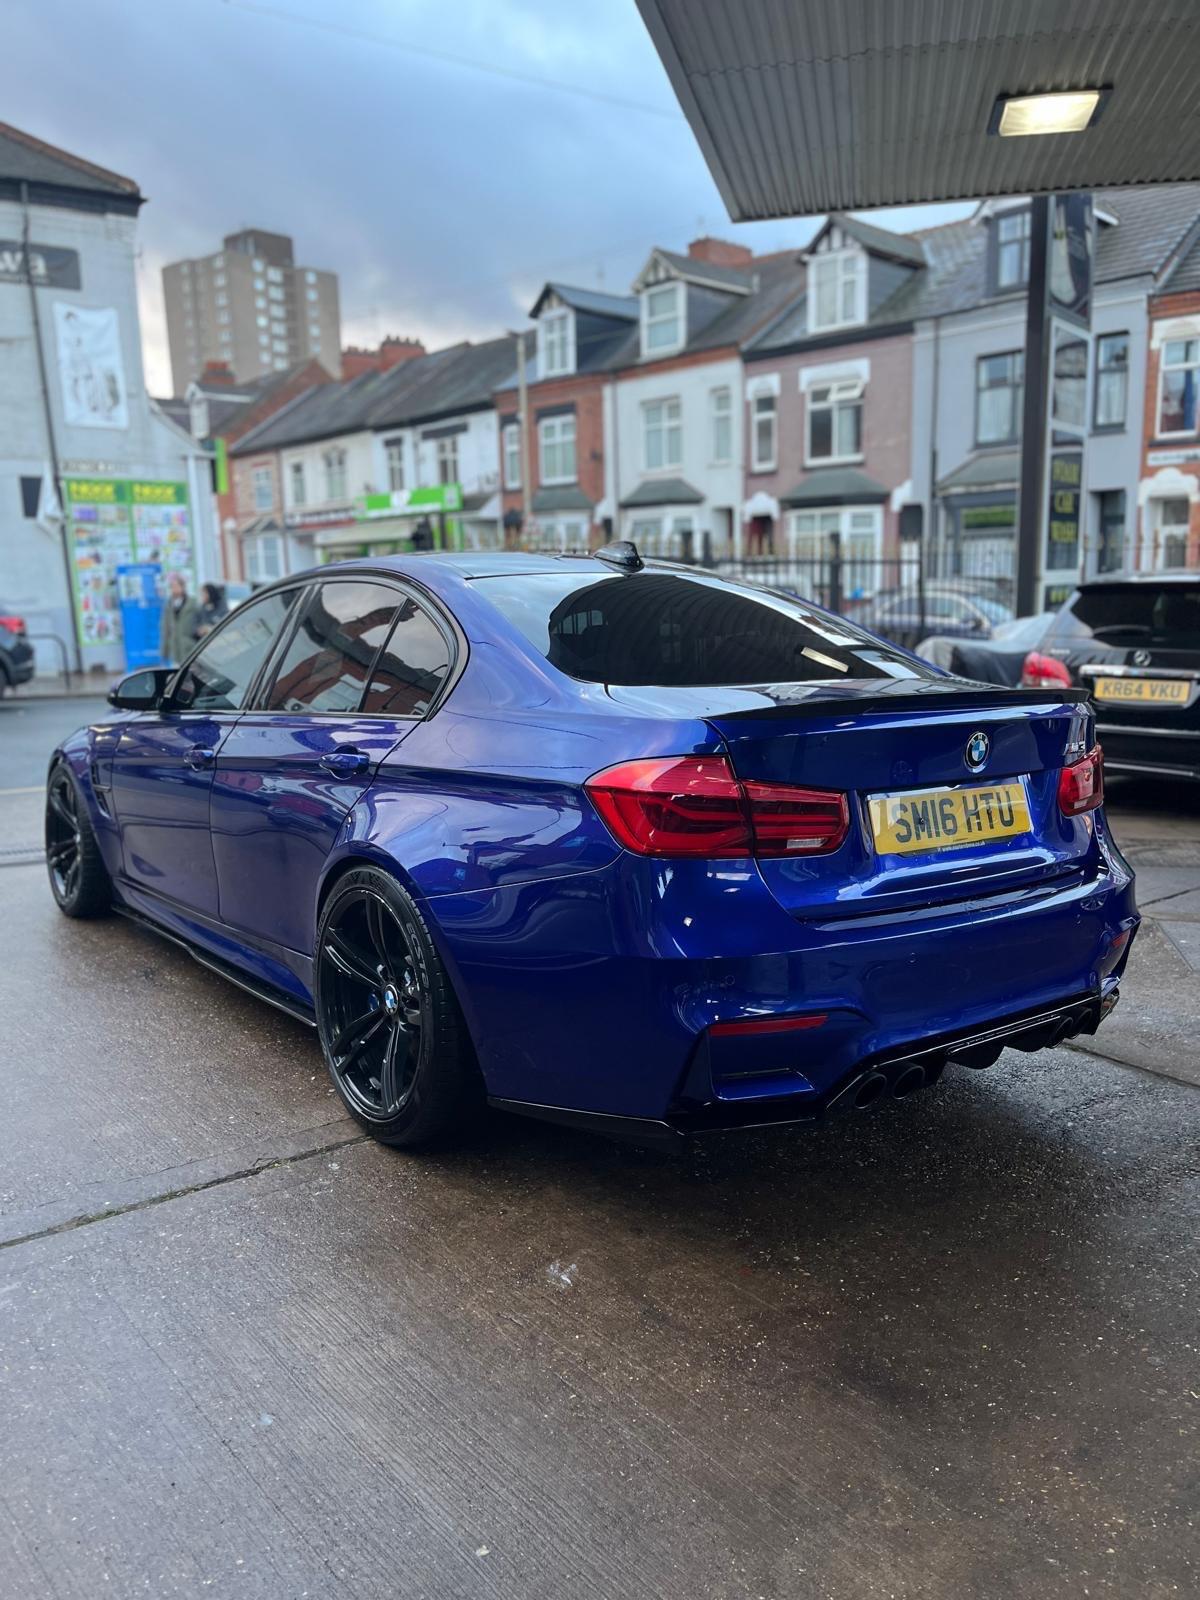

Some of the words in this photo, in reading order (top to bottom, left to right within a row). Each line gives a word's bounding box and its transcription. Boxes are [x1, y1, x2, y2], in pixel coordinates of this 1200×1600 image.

[1102, 681, 1143, 697] KR64
[1149, 683, 1182, 698] VKU
[891, 797, 958, 844] SM16
[962, 790, 1015, 833] HTU
